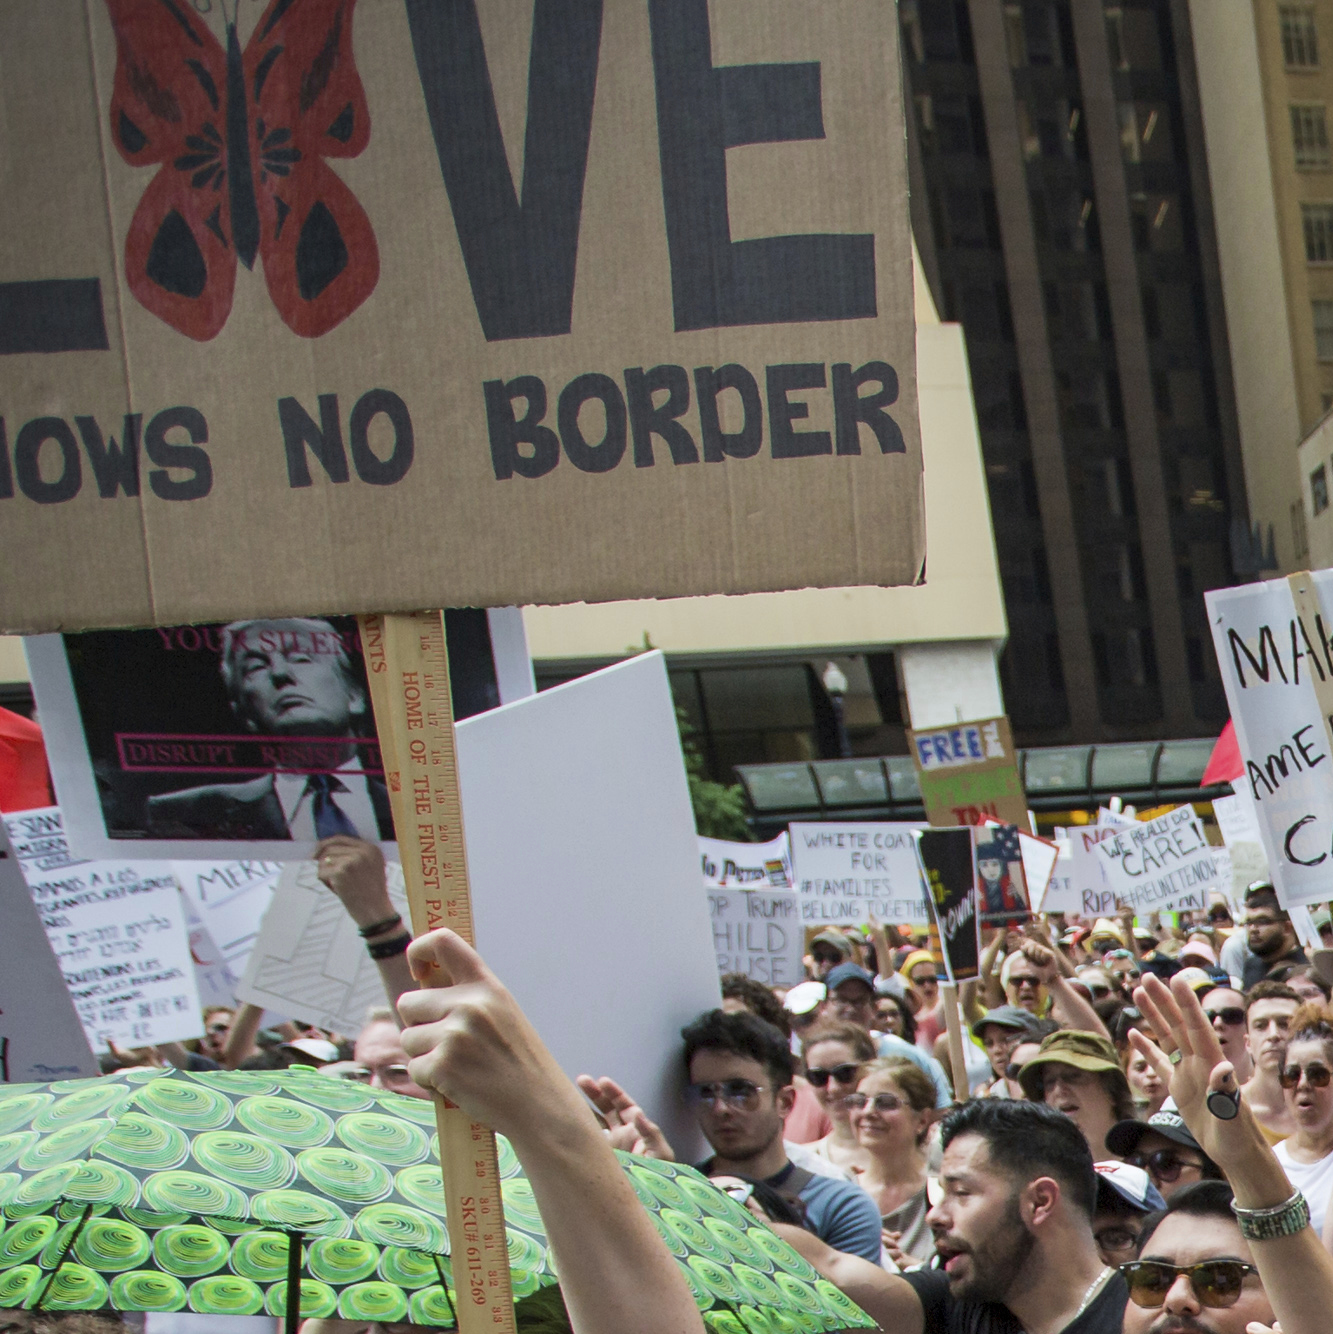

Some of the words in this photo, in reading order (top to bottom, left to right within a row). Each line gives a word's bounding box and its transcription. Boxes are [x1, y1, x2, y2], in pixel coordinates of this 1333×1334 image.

[0, 407, 212, 503] OWS
[279, 388, 414, 489] NO
[482, 361, 907, 481] BORDER
[157, 626, 248, 655] YOUR
[420, 634, 430, 651] 15
[424, 673, 434, 690] 16
[403, 671, 424, 731] HOME
[427, 711, 439, 728] 17
[127, 741, 236, 766] DISRUPT
[409, 740, 426, 766] OF
[915, 729, 982, 766] FREE
[431, 749, 441, 766] 18
[413, 775, 432, 815] THE
[434, 788, 445, 805] 19
[1171, 809, 1190, 825] DO
[438, 825, 449, 843] 20
[803, 832, 867, 849] WHITE
[418, 823, 440, 890] FINEST
[851, 852, 888, 872] FOR
[442, 861, 453, 879] 21
[800, 878, 893, 898] #FAMILIES
[447, 899, 458, 918] 22
[801, 900, 860, 919] BELONG
[475, 1160, 486, 1178] 29
[479, 1197, 490, 1215] 30
[460, 1196, 481, 1242] SKU#
[483, 1233, 494, 1252] 31
[466, 1246, 486, 1306] 611-269
[488, 1269, 499, 1288] 32
